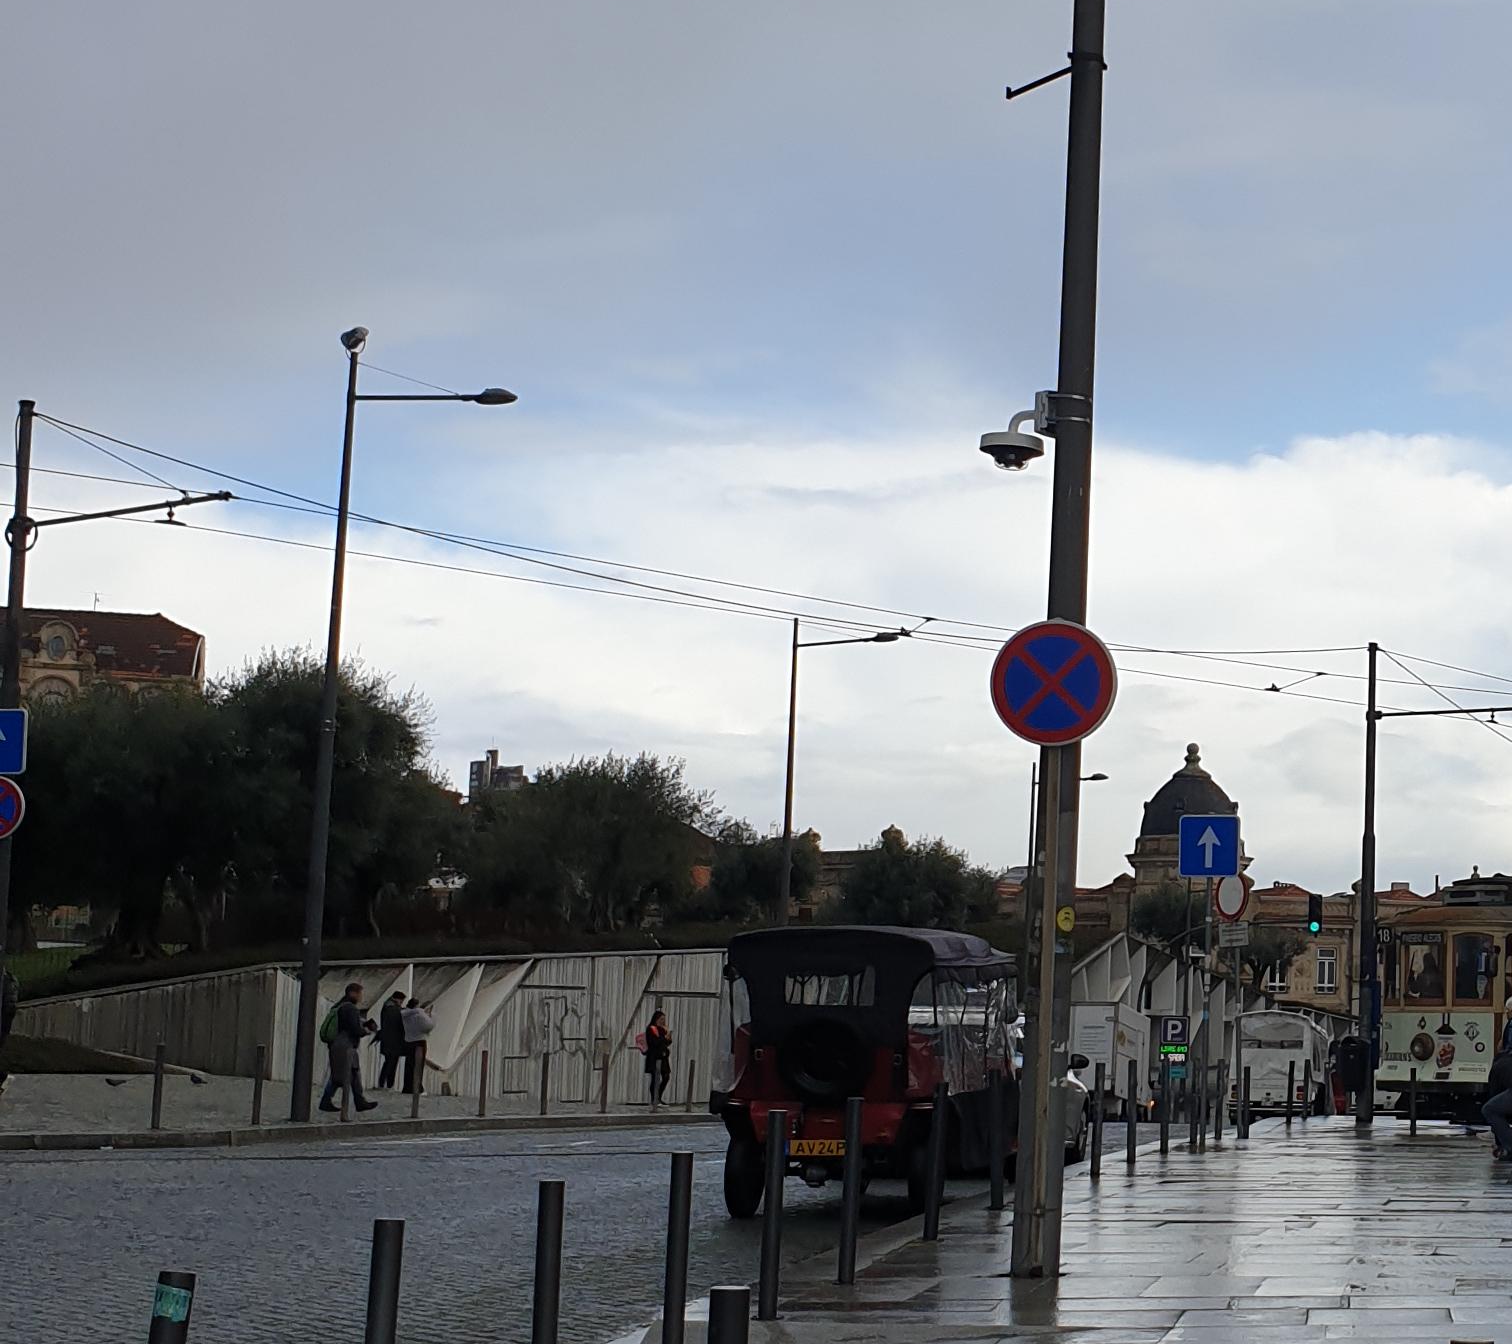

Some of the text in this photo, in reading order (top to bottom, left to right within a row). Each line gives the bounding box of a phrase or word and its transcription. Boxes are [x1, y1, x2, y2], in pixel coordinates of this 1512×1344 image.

[1377, 928, 1390, 943] 18
[1167, 1020, 1182, 1041] P
[796, 1141, 846, 1155] AV24P
